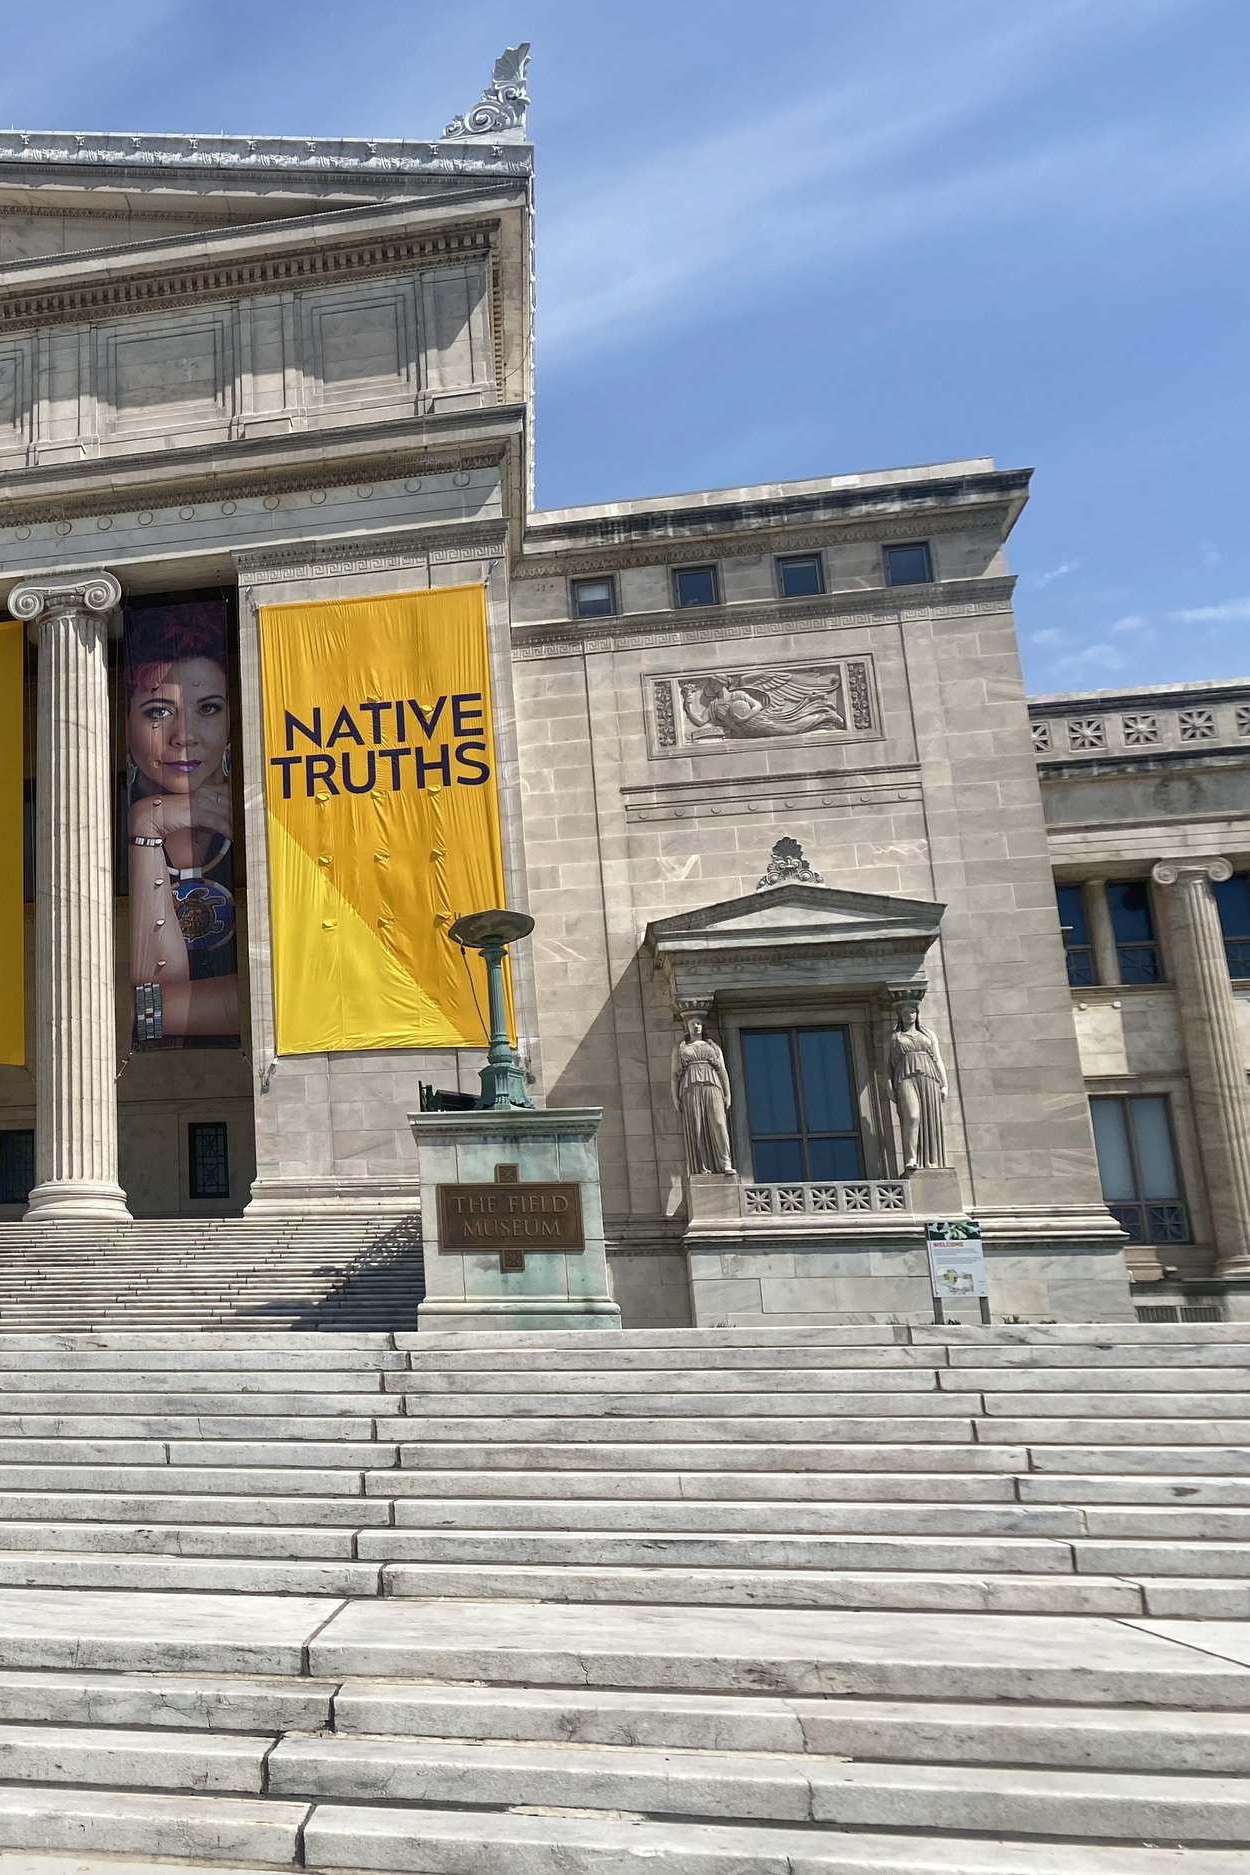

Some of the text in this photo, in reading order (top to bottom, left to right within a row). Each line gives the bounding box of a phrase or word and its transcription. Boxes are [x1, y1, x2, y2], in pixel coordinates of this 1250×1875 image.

[284, 692, 485, 750] NATIVE
[270, 741, 491, 799] TRUTHS
[453, 1195, 569, 1215] THE FIELD
[463, 1218, 562, 1238] MUSEUM
